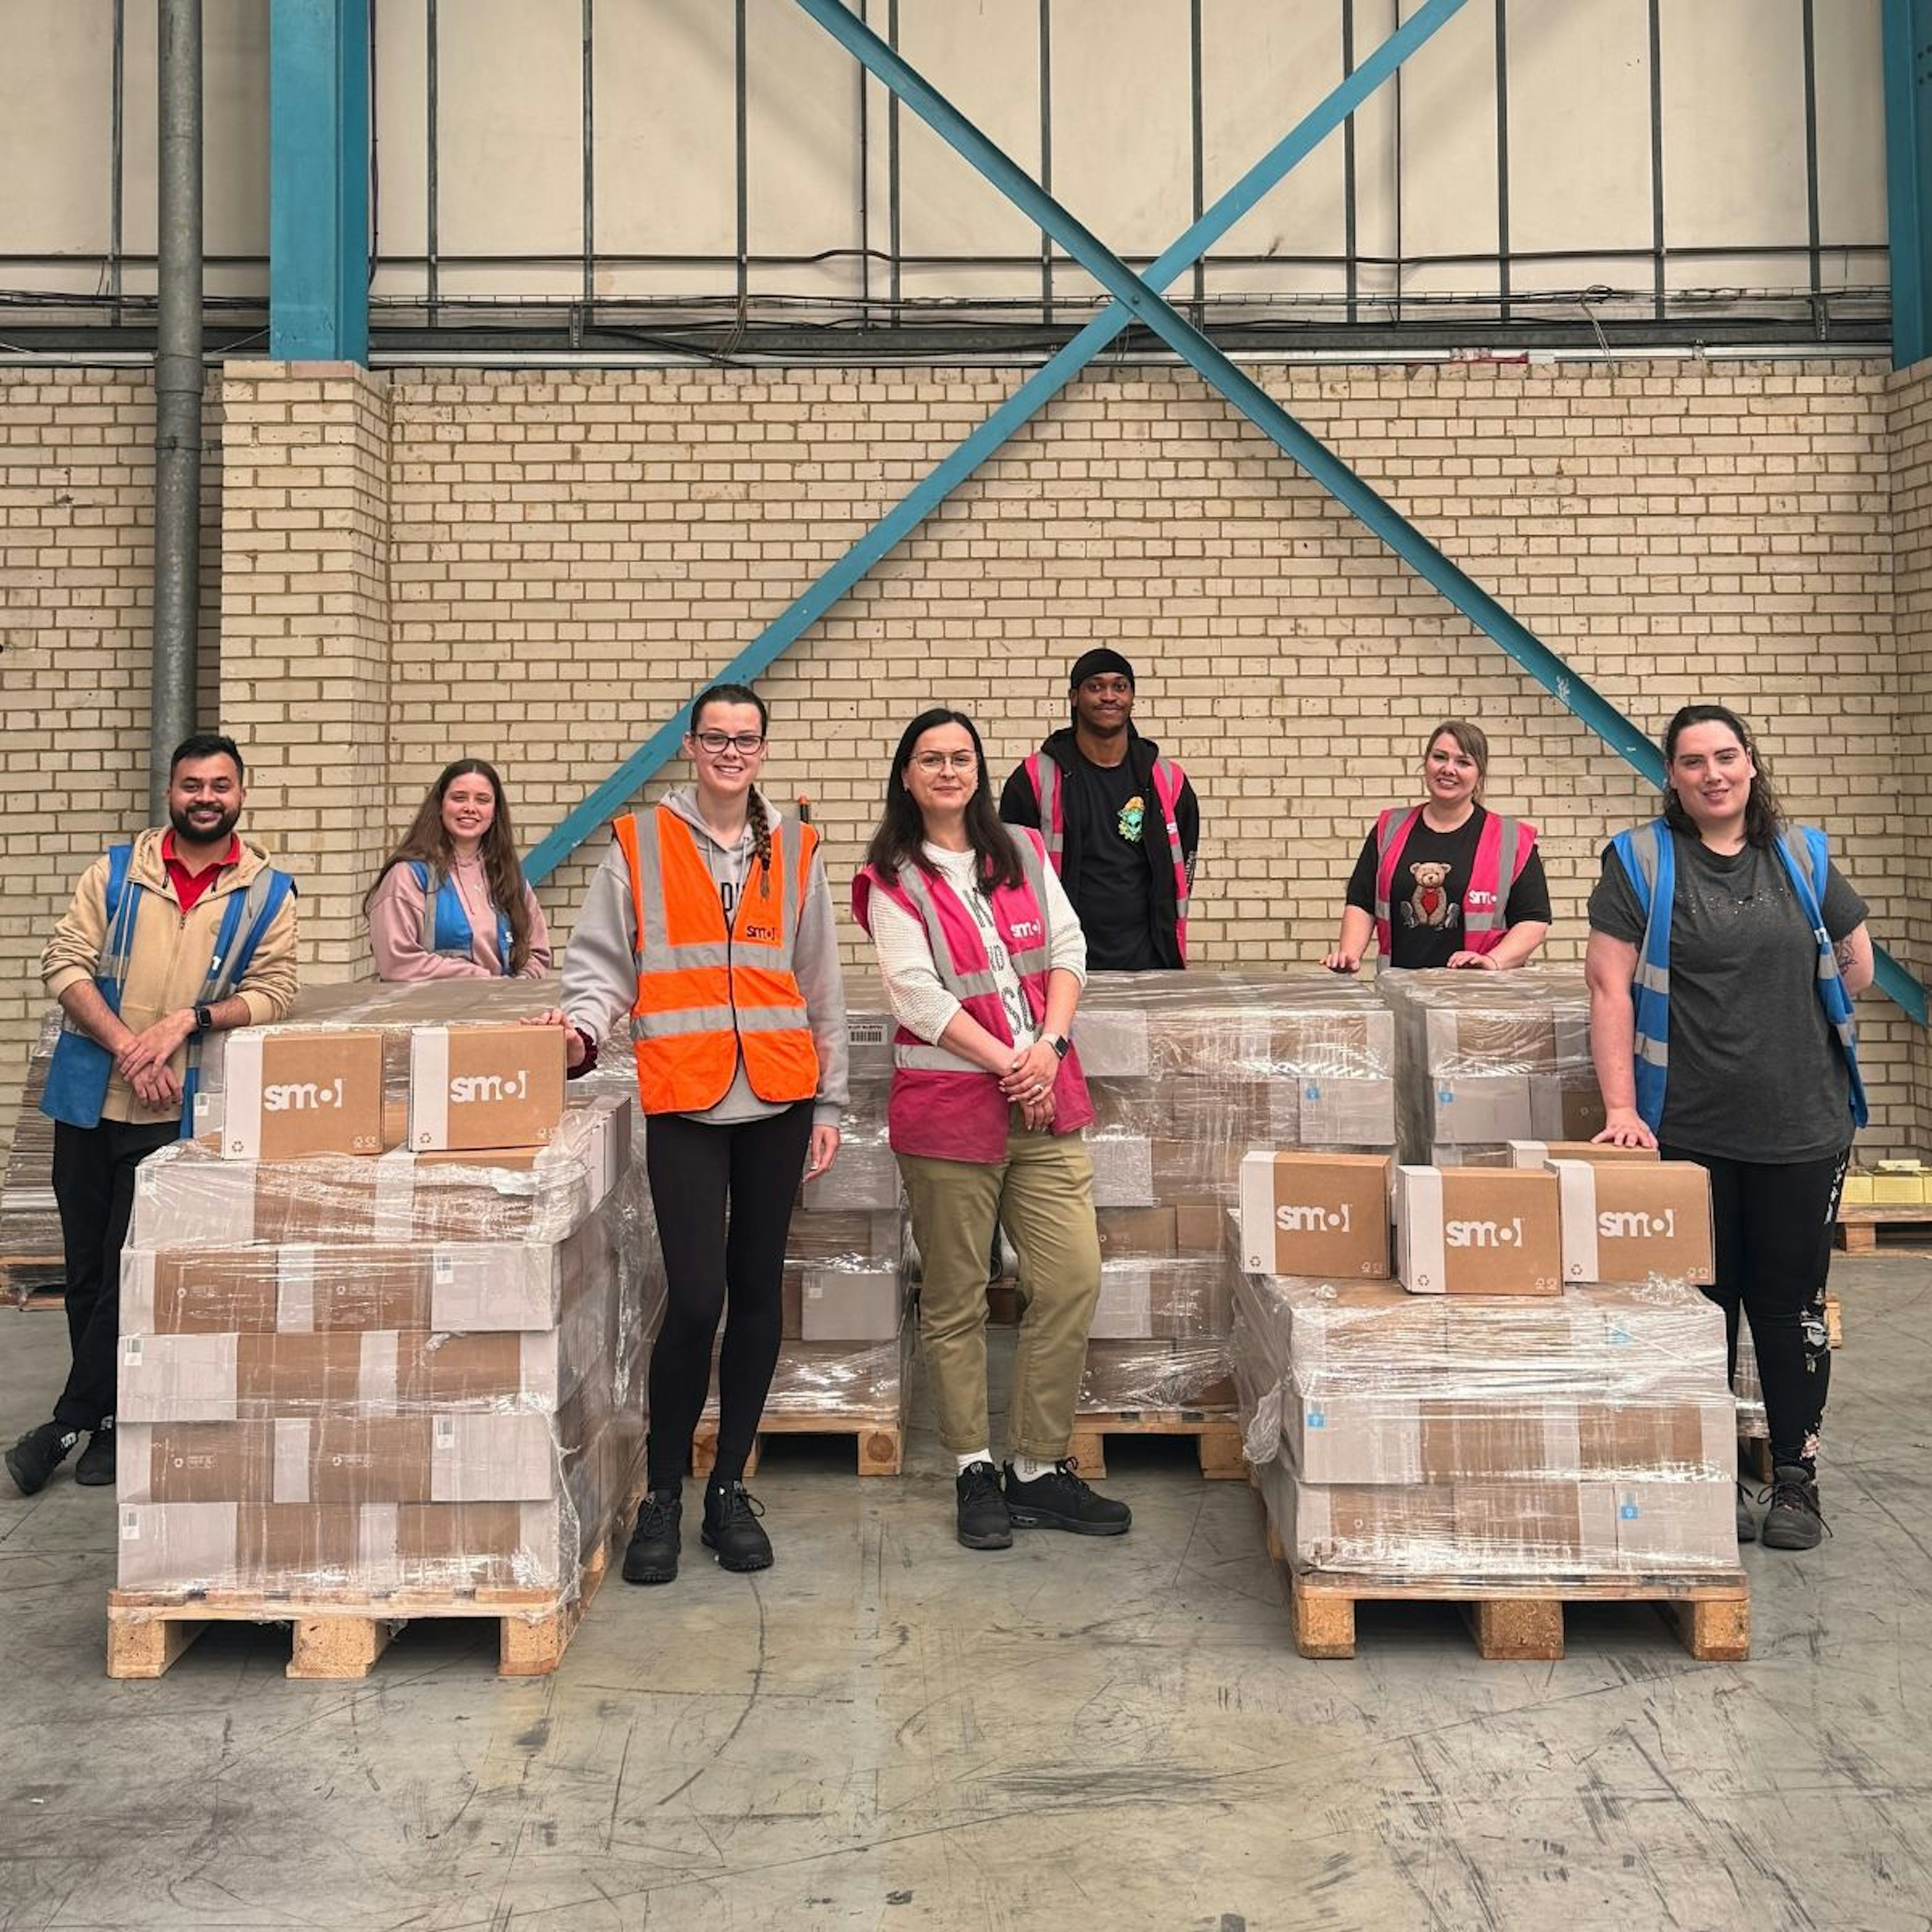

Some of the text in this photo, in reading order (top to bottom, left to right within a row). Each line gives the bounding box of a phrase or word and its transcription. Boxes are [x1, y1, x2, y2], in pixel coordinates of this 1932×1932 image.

[264, 1078, 342, 1111] smol
[450, 1070, 526, 1102] smol
[1276, 1204, 1350, 1232] smol
[1445, 1218, 1522, 1247] smol
[1598, 1209, 1674, 1237] smol
